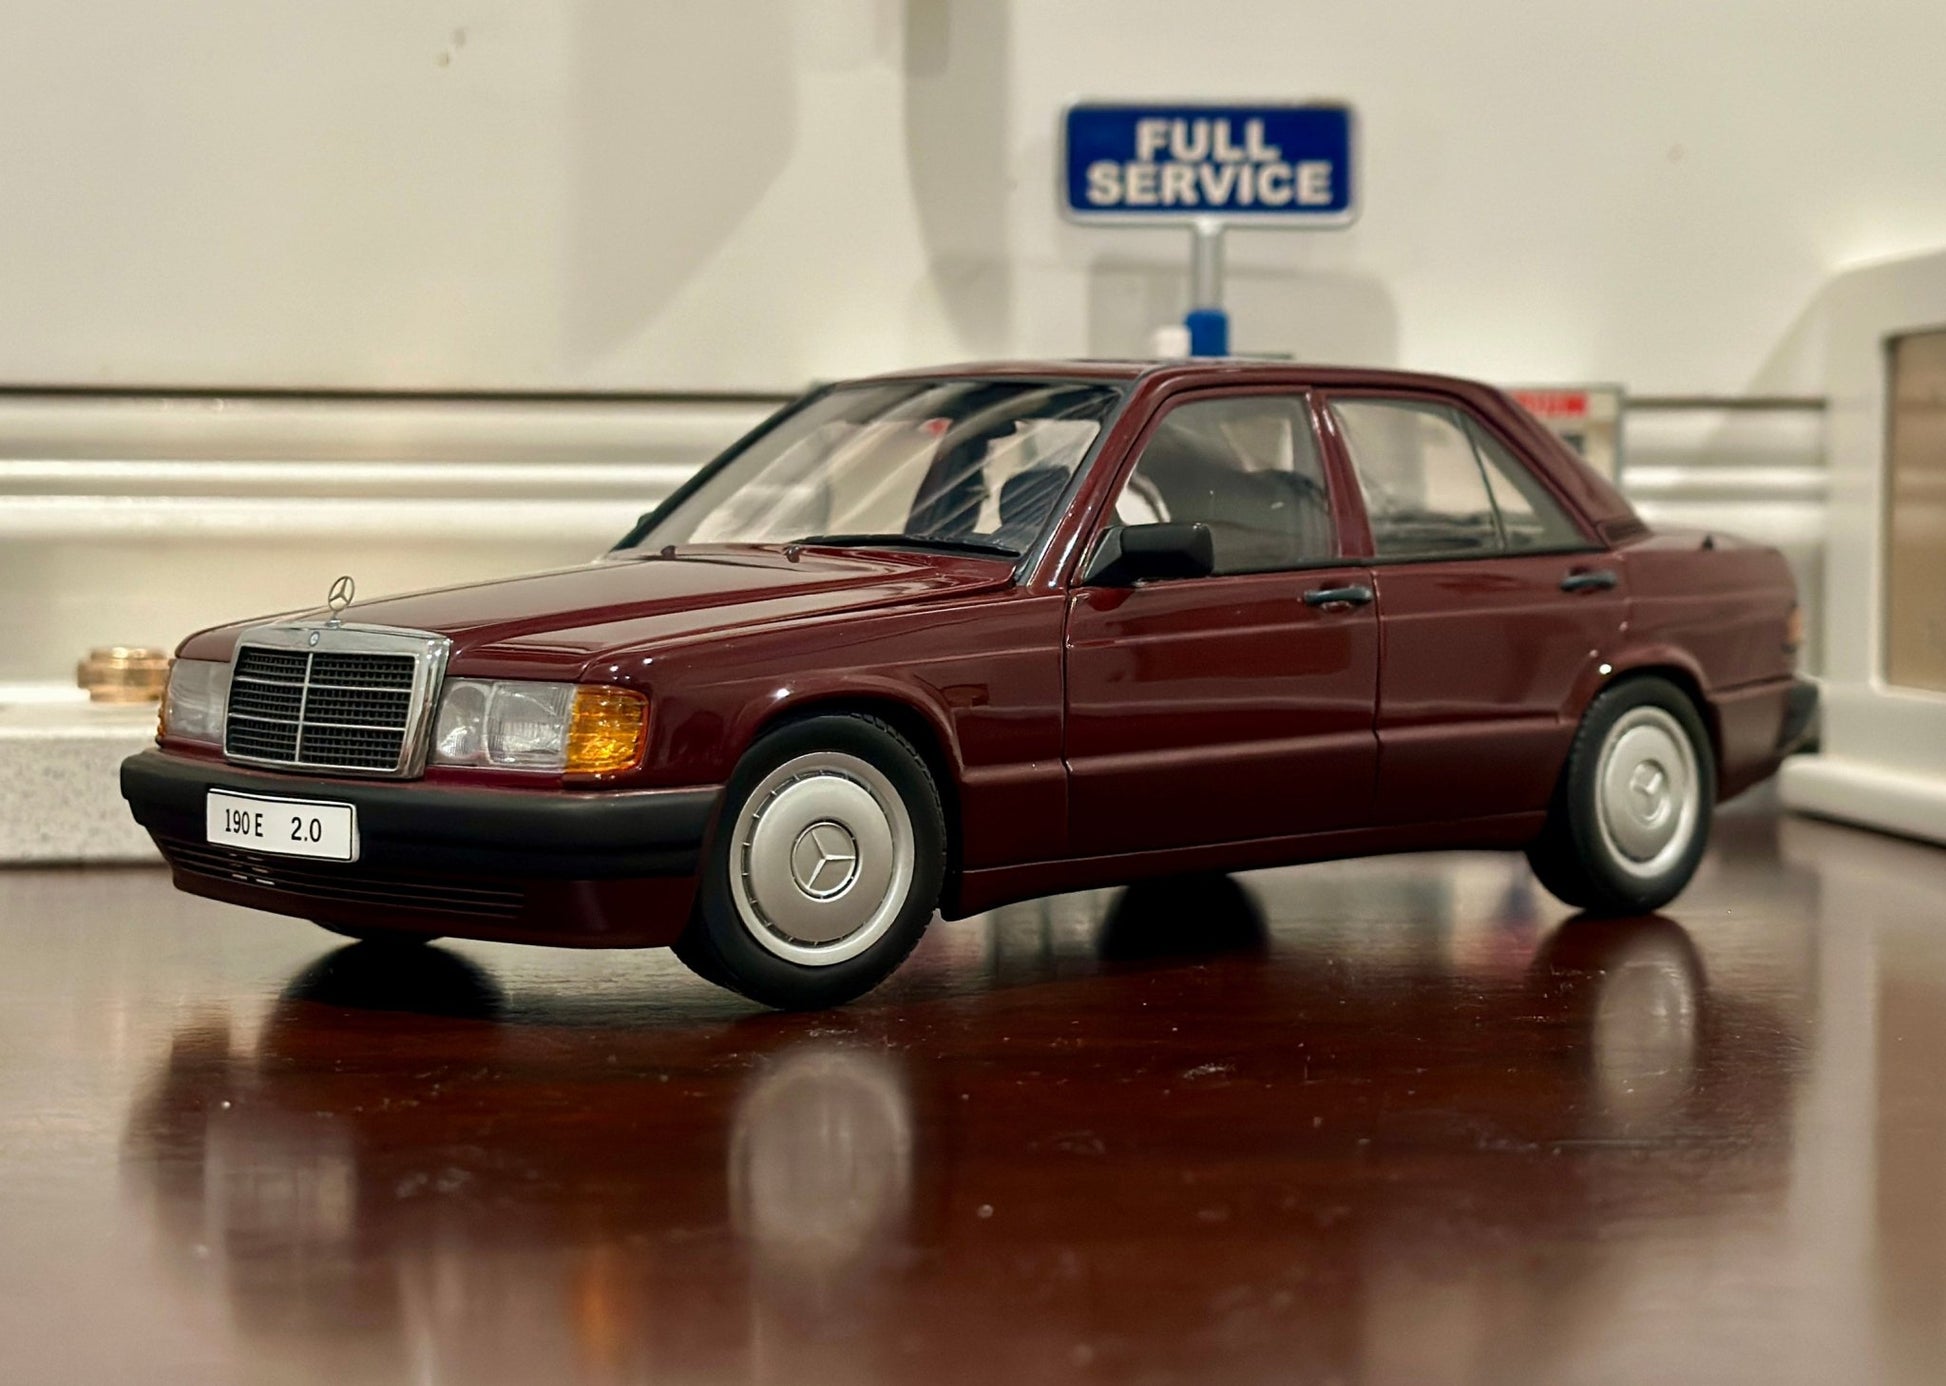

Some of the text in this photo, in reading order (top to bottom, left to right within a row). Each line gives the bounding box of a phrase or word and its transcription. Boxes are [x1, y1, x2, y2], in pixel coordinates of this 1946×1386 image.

[1136, 118, 1280, 161] FULL
[1086, 160, 1333, 205] SERVICE
[291, 816, 322, 842] 2.0
